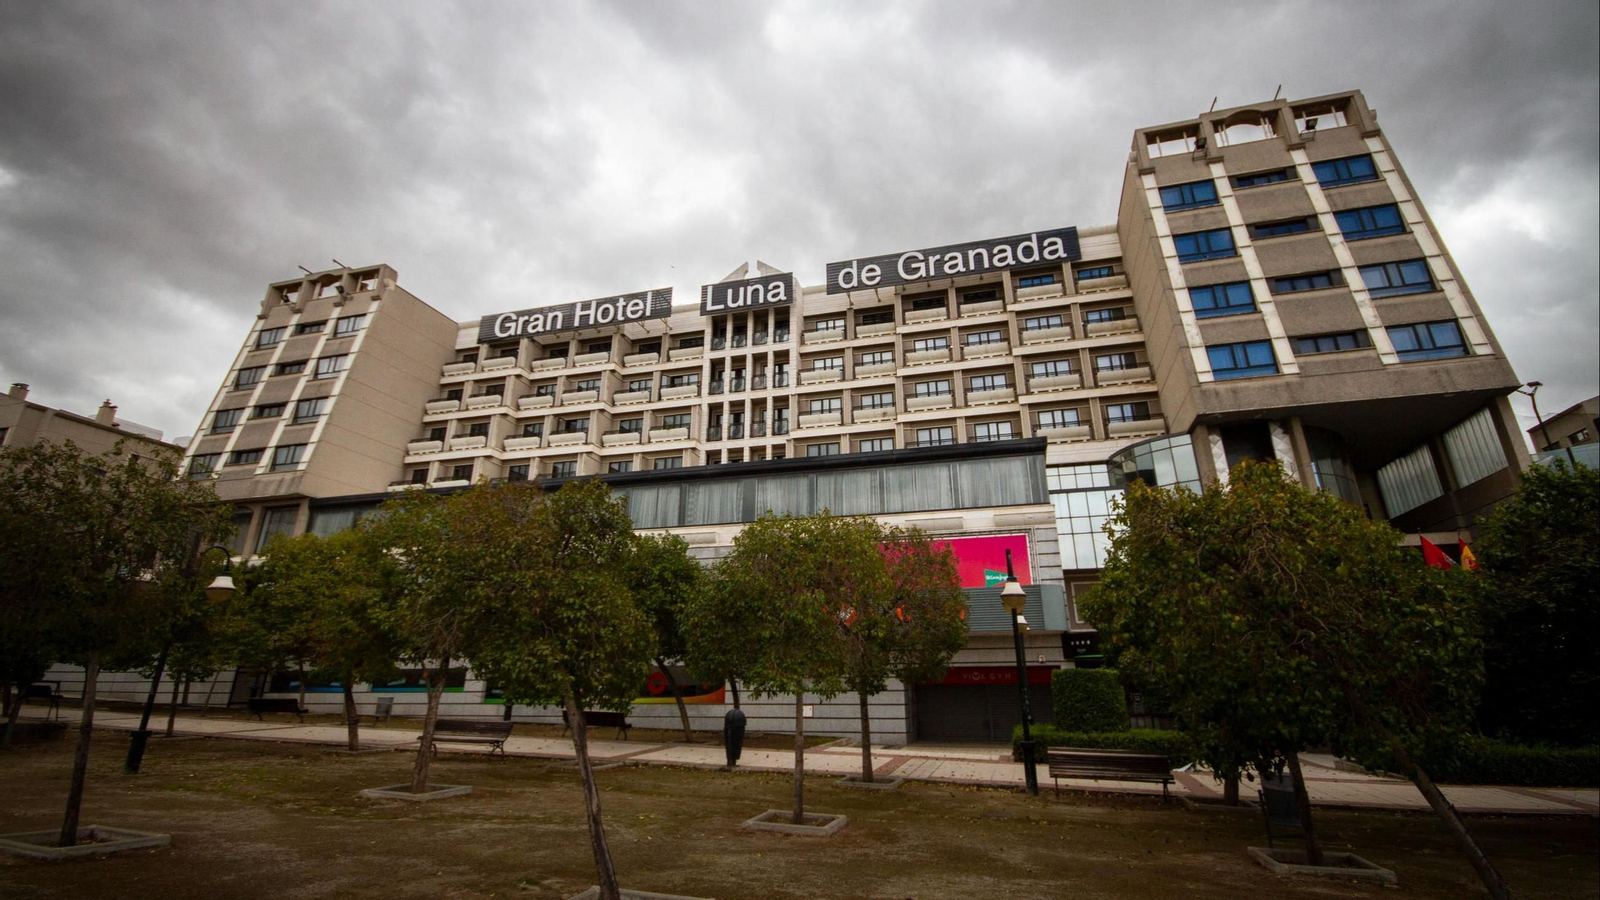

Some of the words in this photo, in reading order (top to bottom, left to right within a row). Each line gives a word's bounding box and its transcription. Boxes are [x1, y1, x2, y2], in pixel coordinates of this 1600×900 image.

[838, 258, 881, 289] de
[897, 233, 1067, 280] Granada
[494, 311, 563, 338] Gran
[573, 291, 652, 327] Hotel
[706, 280, 787, 311] Luna
[989, 672, 1011, 681] GYM
